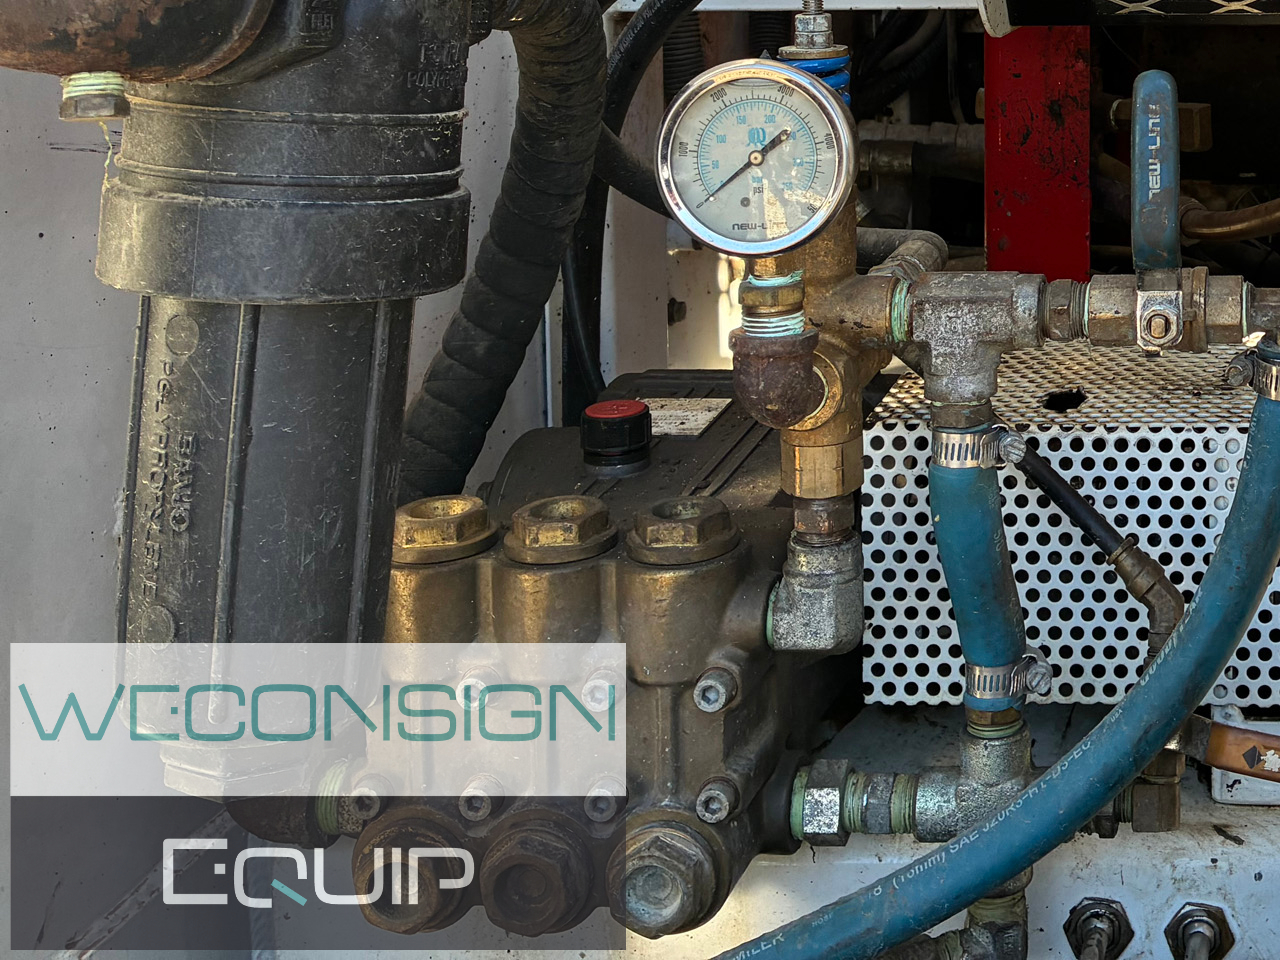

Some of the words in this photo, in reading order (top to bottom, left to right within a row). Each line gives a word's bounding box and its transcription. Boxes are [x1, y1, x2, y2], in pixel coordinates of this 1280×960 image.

[710, 87, 728, 103] 2000
[678, 141, 689, 157] 1000
[711, 160, 720, 170] 50
